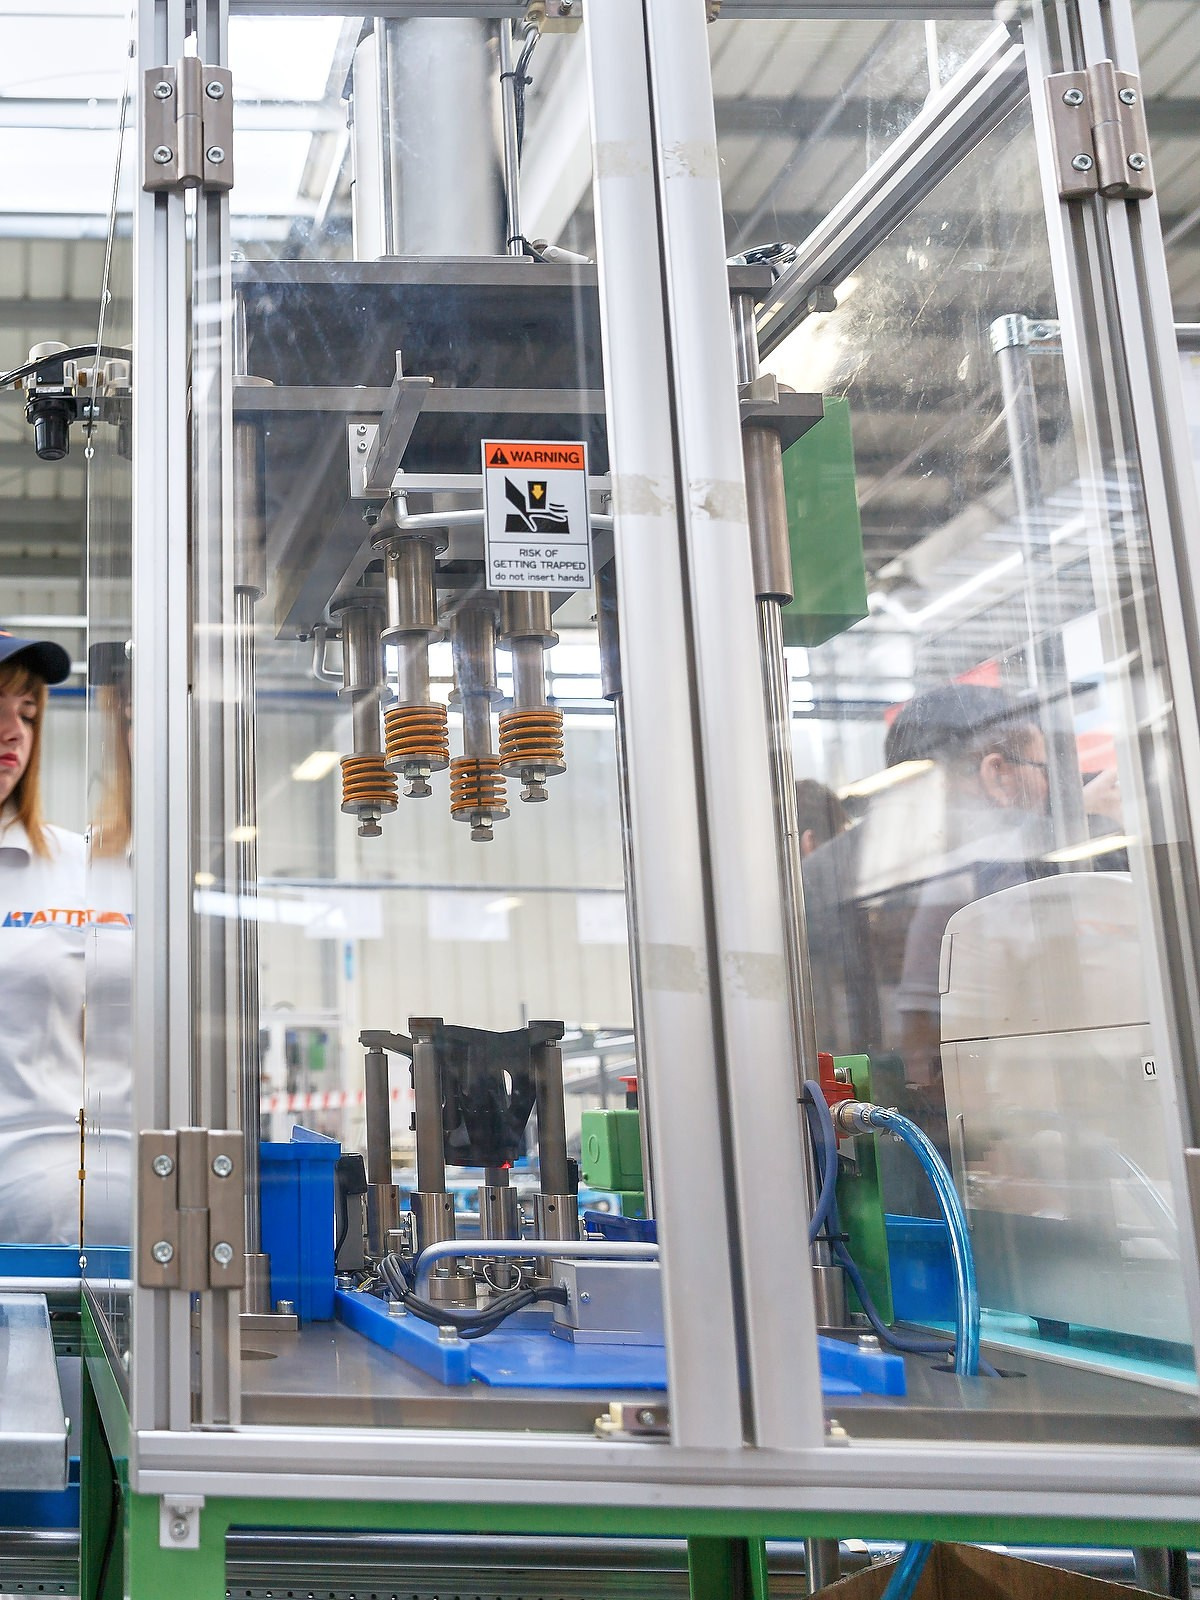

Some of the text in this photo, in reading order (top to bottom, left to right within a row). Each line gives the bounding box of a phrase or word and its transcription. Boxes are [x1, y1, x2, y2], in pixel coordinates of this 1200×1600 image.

[510, 451, 580, 464] WARNING
[519, 548, 559, 558] RISK OF
[493, 560, 586, 570] GETTING TRAPPED
[495, 572, 585, 582] do not insert hands
